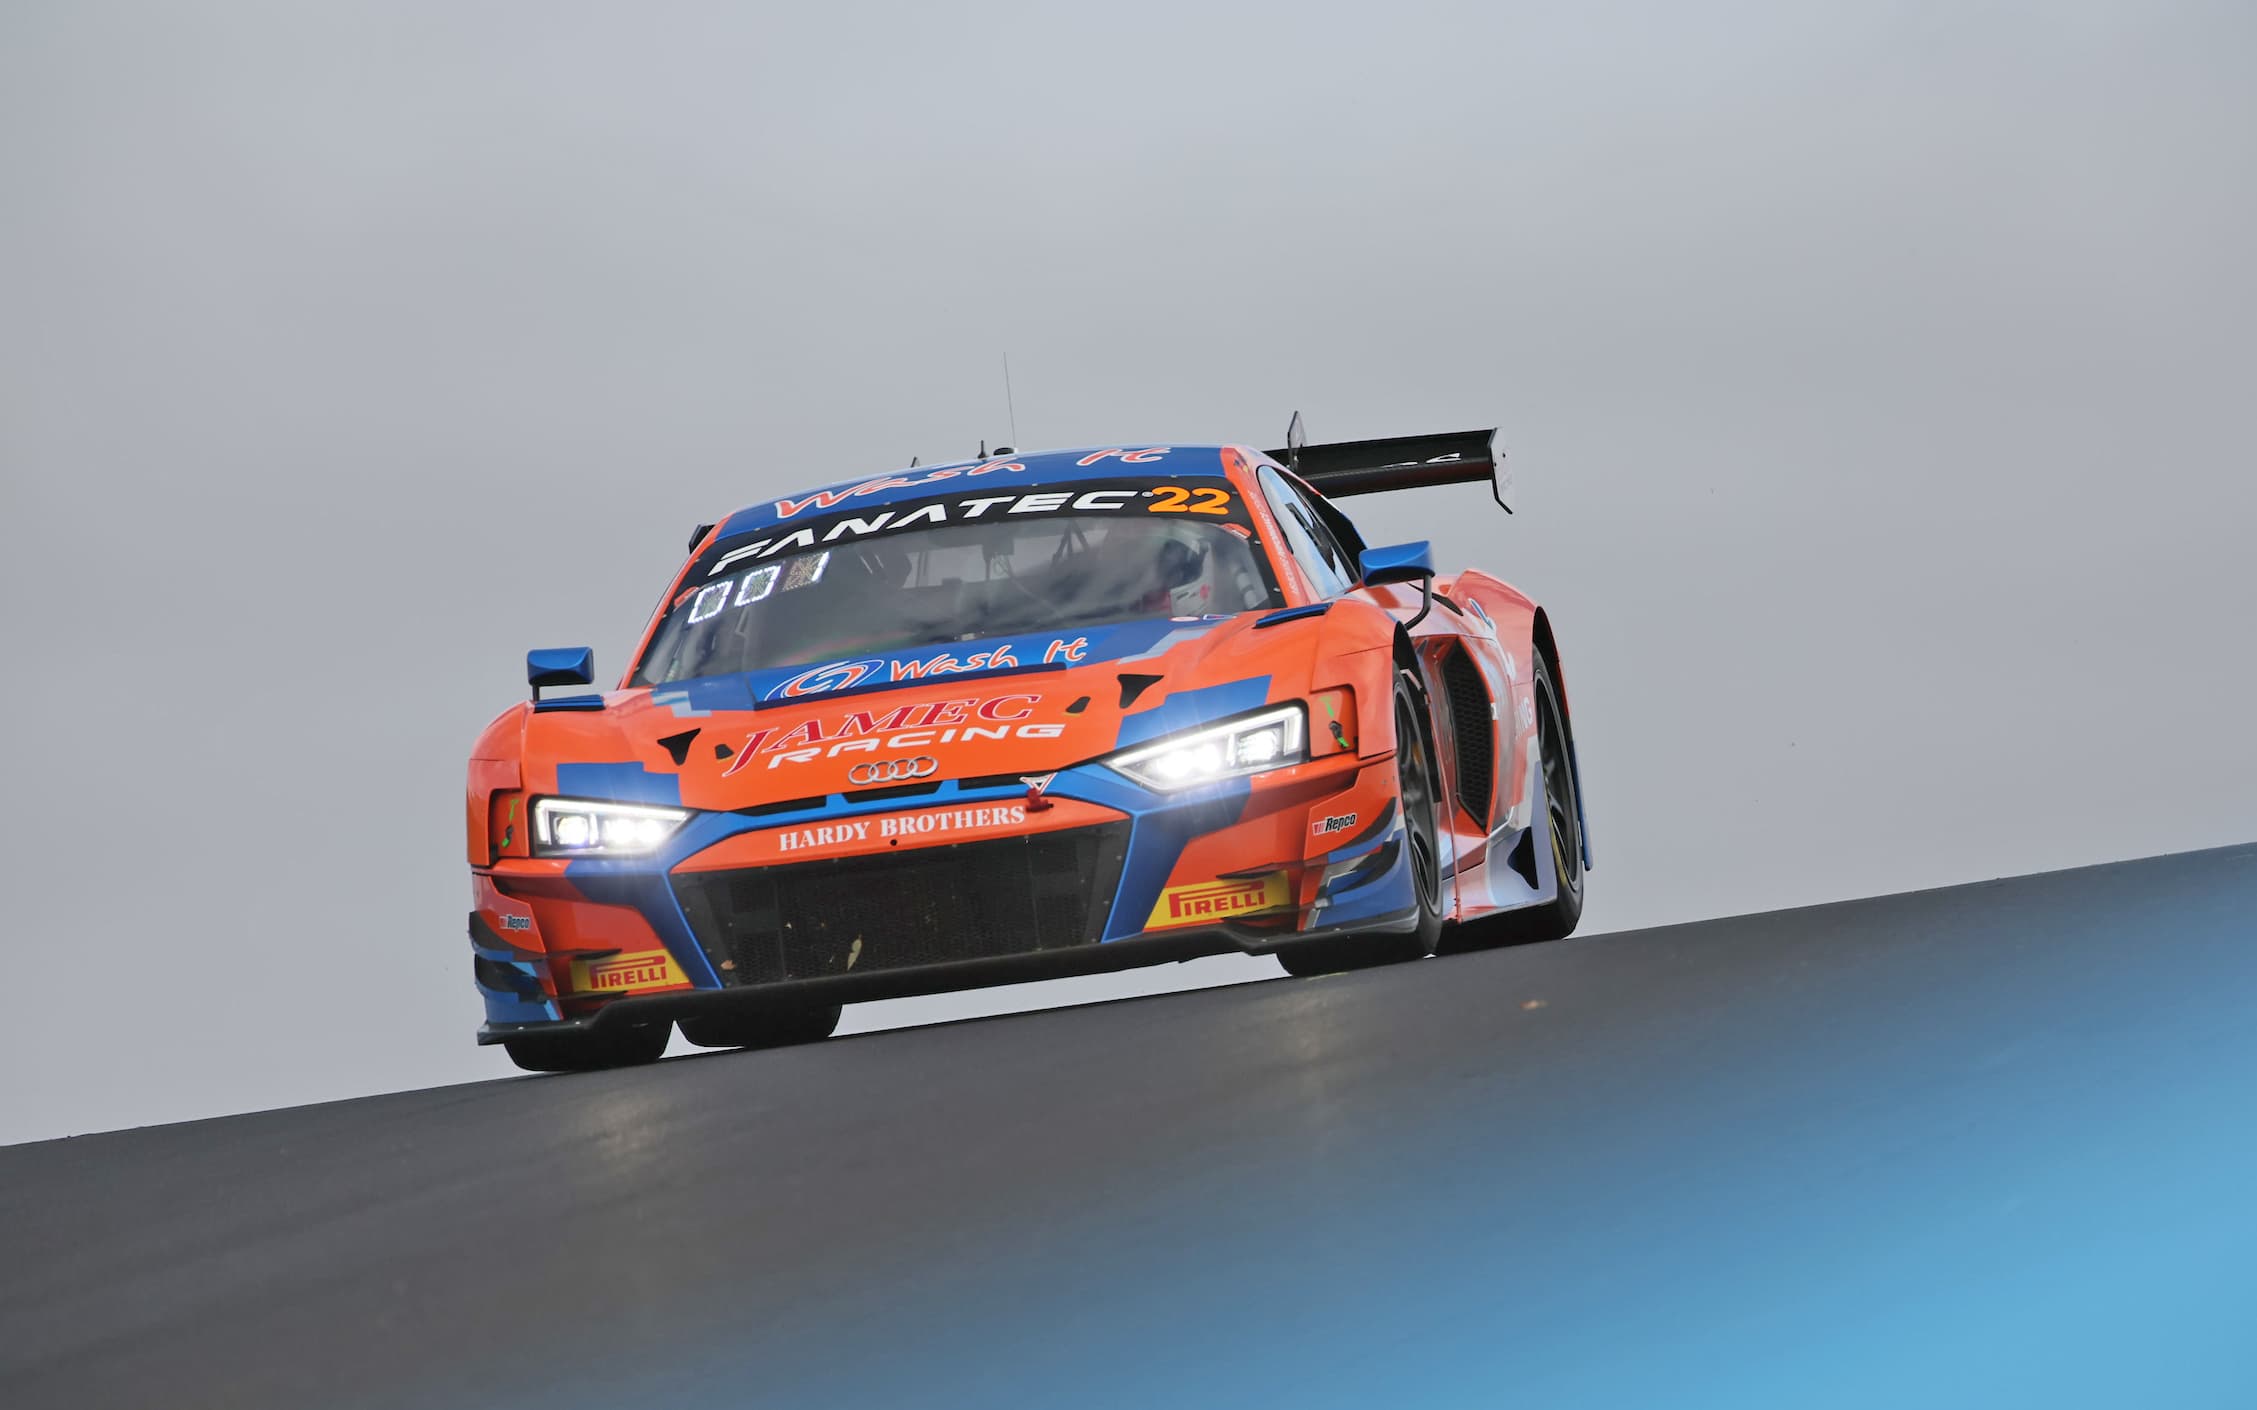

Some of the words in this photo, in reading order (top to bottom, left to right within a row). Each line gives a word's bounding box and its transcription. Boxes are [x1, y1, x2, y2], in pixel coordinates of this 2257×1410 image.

[775, 457, 1025, 518] Wash
[1076, 447, 1171, 467] It
[1148, 486, 1231, 515] 22
[708, 490, 1139, 576] FANATEC
[890, 644, 1018, 682] Wash
[1043, 635, 1087, 663] It
[722, 693, 1042, 777] JAMEC
[768, 723, 1065, 770] RACING
[778, 821, 870, 852] HARDY
[880, 805, 1026, 838] BROTHERS
[1325, 813, 1357, 832] Repco
[507, 914, 530, 931] Repco
[1168, 881, 1265, 918] PIRELLI
[589, 955, 667, 989] PIRELLI
